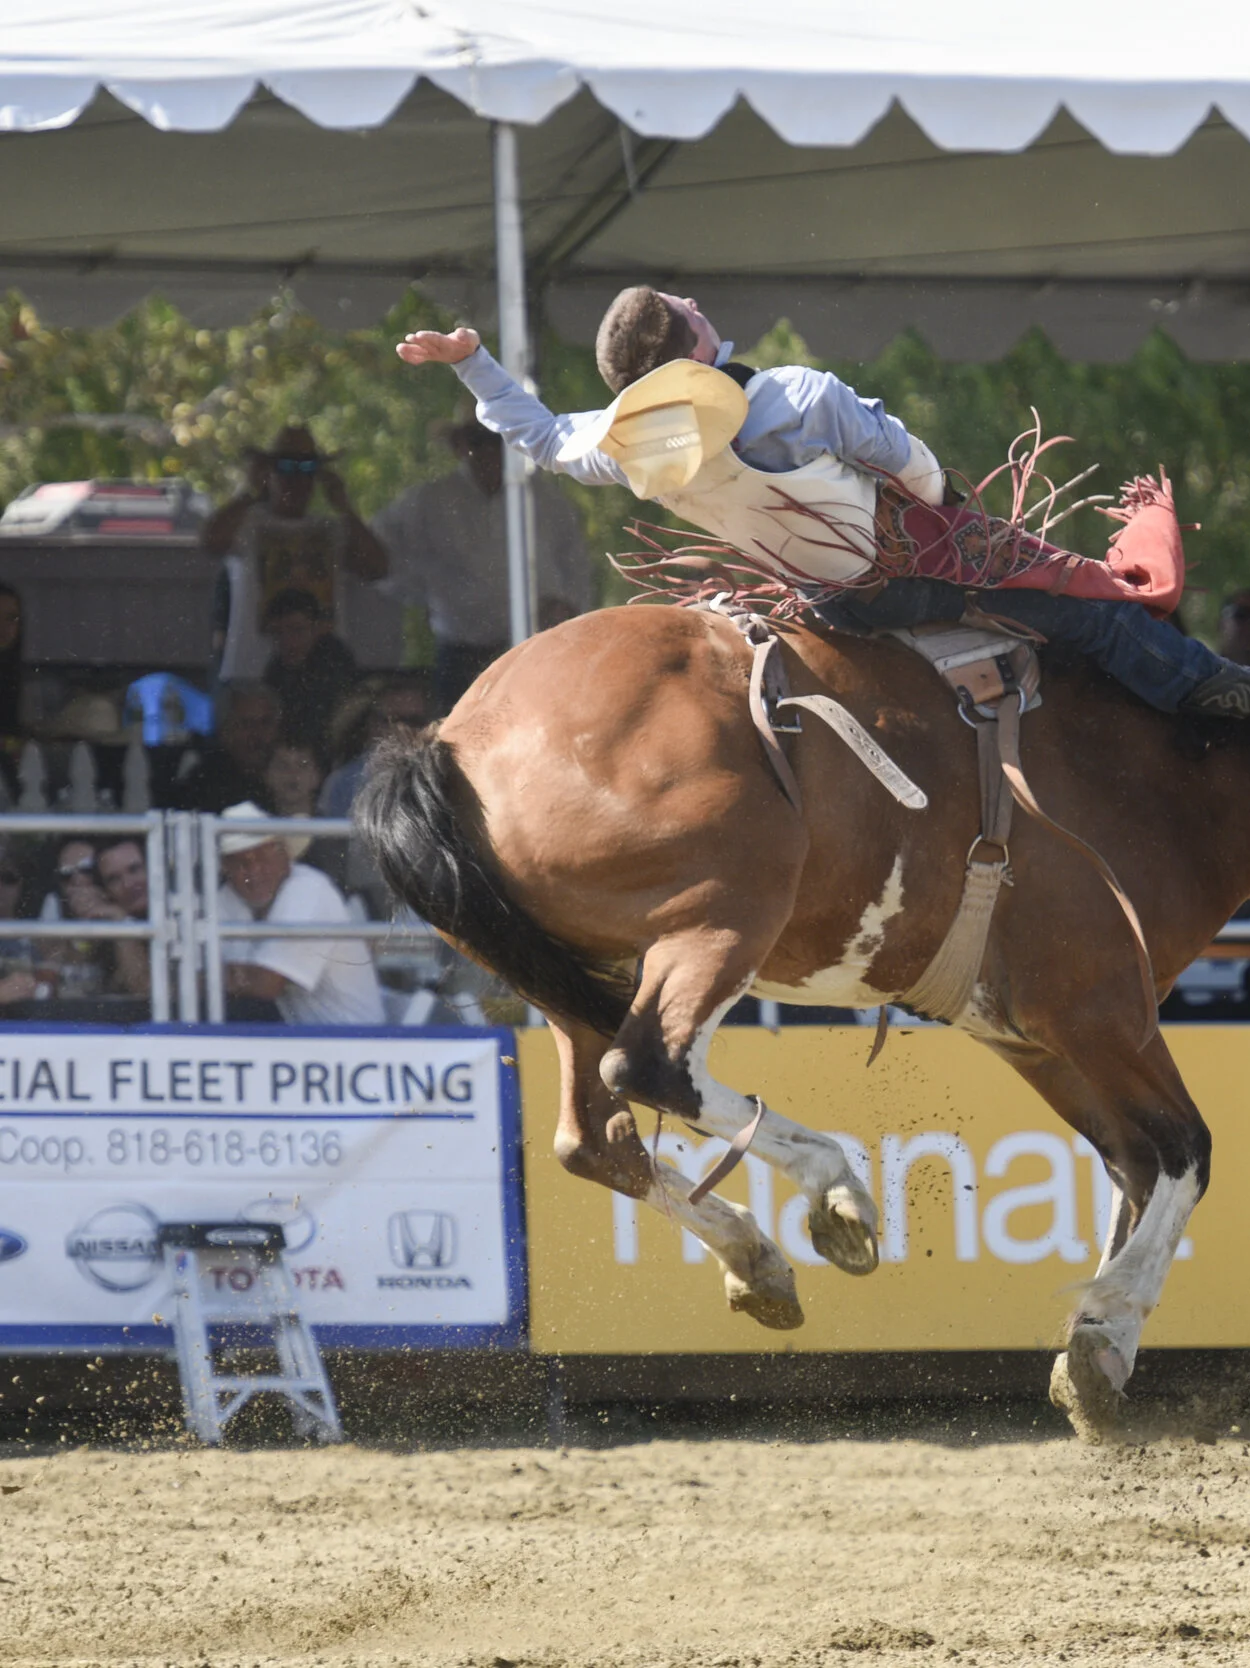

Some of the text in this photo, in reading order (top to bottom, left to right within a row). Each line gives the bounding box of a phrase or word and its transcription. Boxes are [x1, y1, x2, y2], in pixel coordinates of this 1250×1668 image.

[0, 1058, 474, 1104] IAL FLEET PRICING
[107, 1127, 342, 1168] 818-618-6136
[210, 1267, 344, 1292] TOTA
[377, 1275, 473, 1291] HONDA
